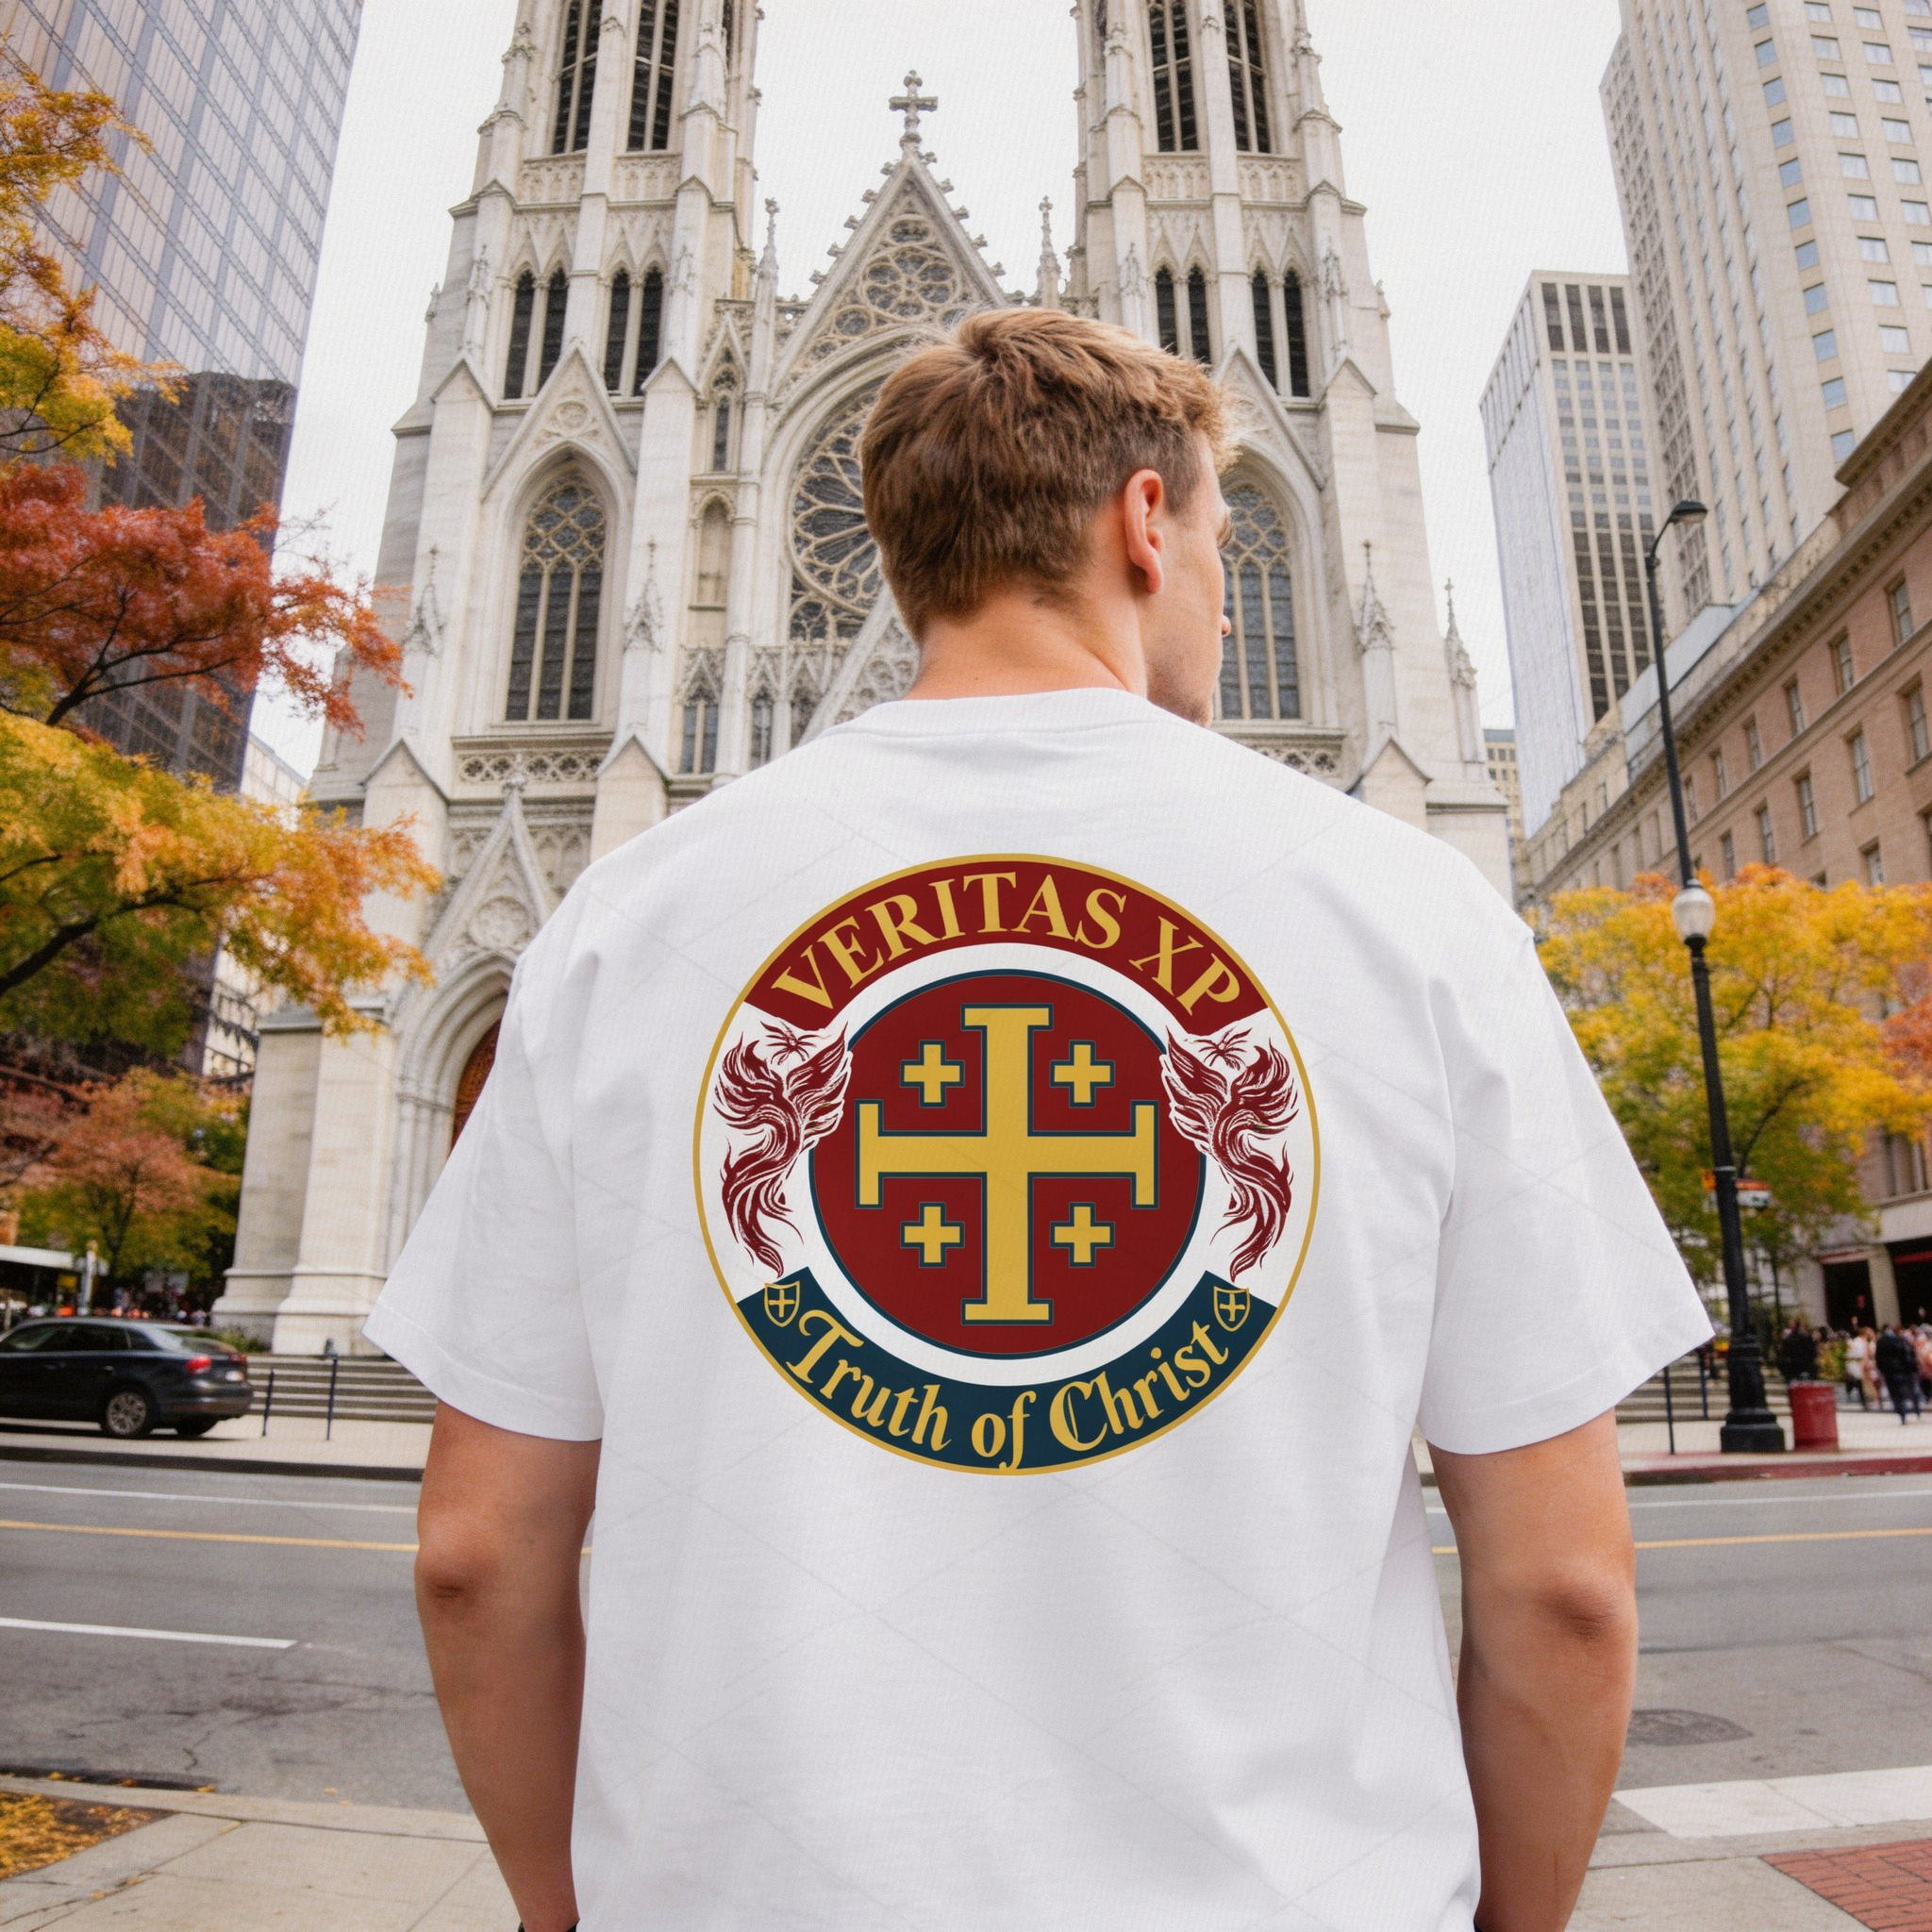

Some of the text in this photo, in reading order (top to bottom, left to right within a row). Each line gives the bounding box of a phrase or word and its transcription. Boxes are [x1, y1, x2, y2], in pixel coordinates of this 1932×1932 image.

[771, 872, 1241, 1016] VERITAS XP
[785, 1308, 1229, 1471] Truth of Christ
